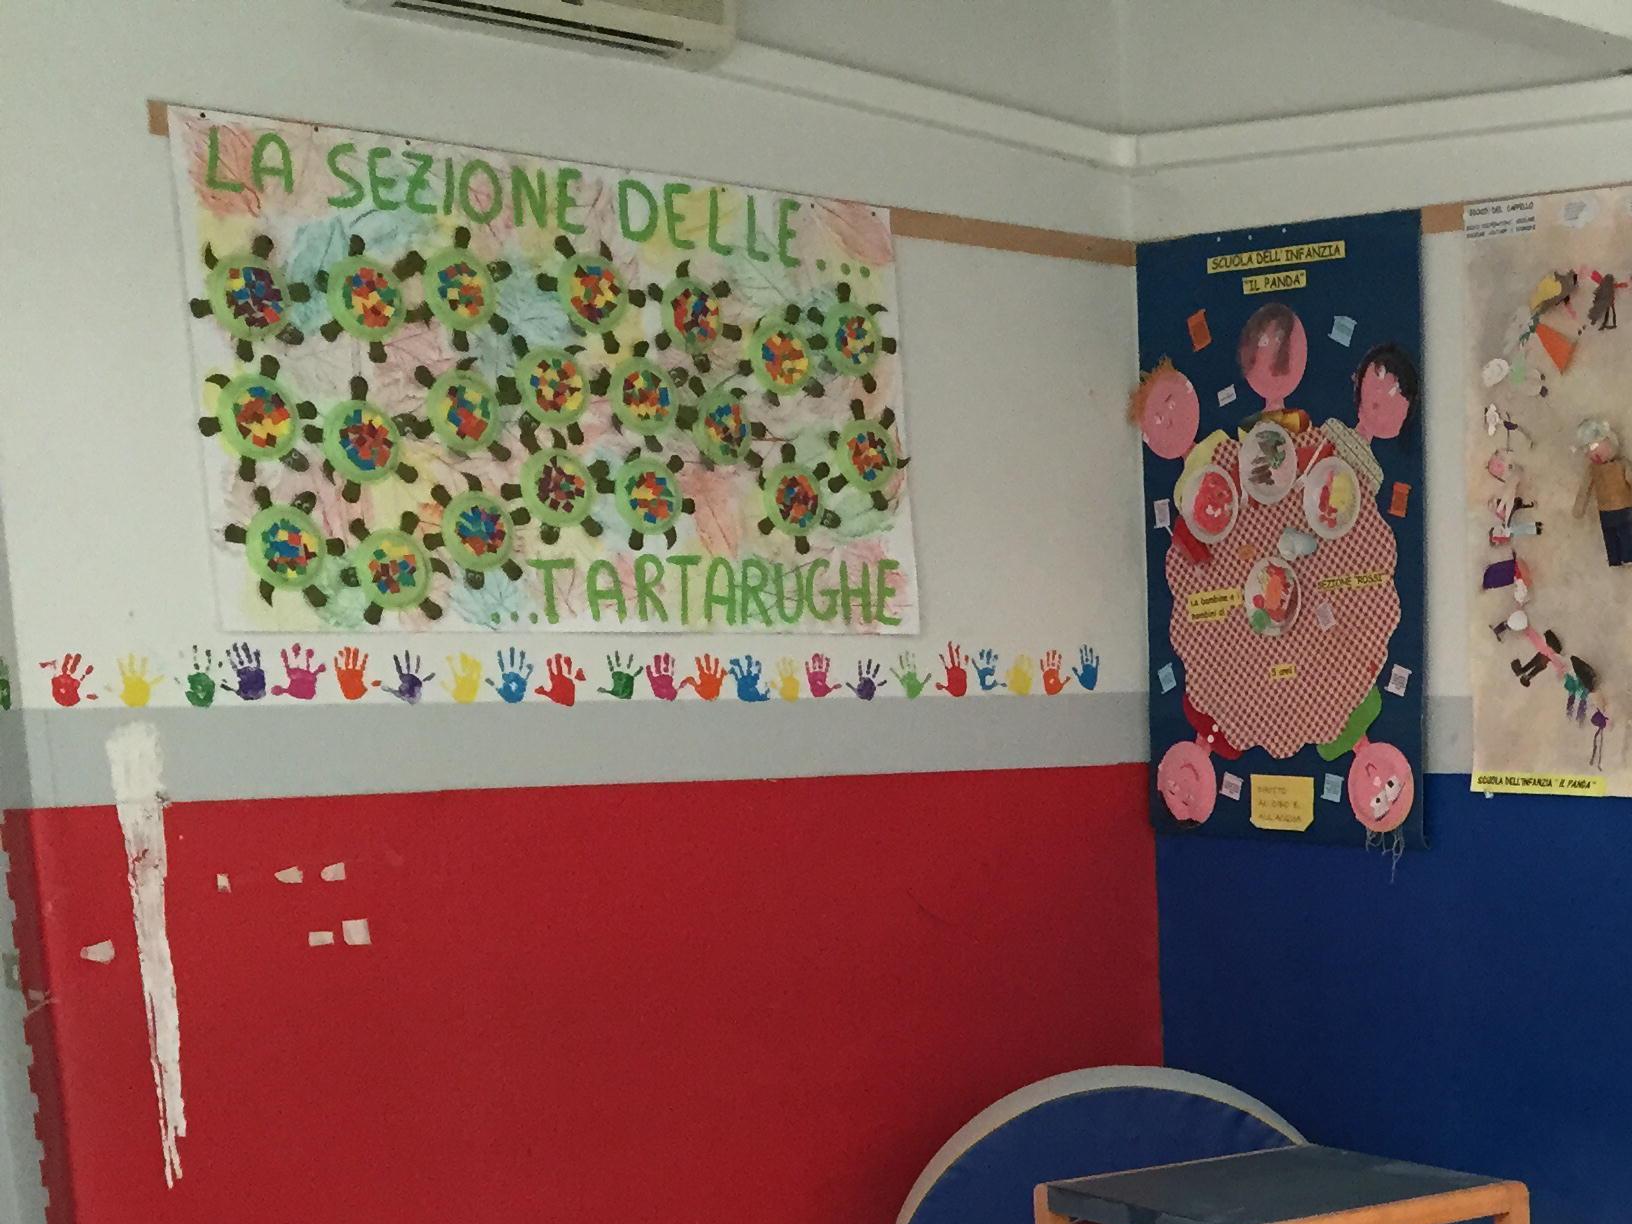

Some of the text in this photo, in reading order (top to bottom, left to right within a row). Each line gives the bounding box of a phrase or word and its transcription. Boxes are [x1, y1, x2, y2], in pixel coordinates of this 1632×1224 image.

[205, 125, 294, 194] LA
[327, 142, 586, 235] SEZIONE
[1212, 256, 1254, 270] SCUOLA
[1245, 272, 1305, 292] "IL PANDA"
[1477, 776, 1503, 785] SCUOLA
